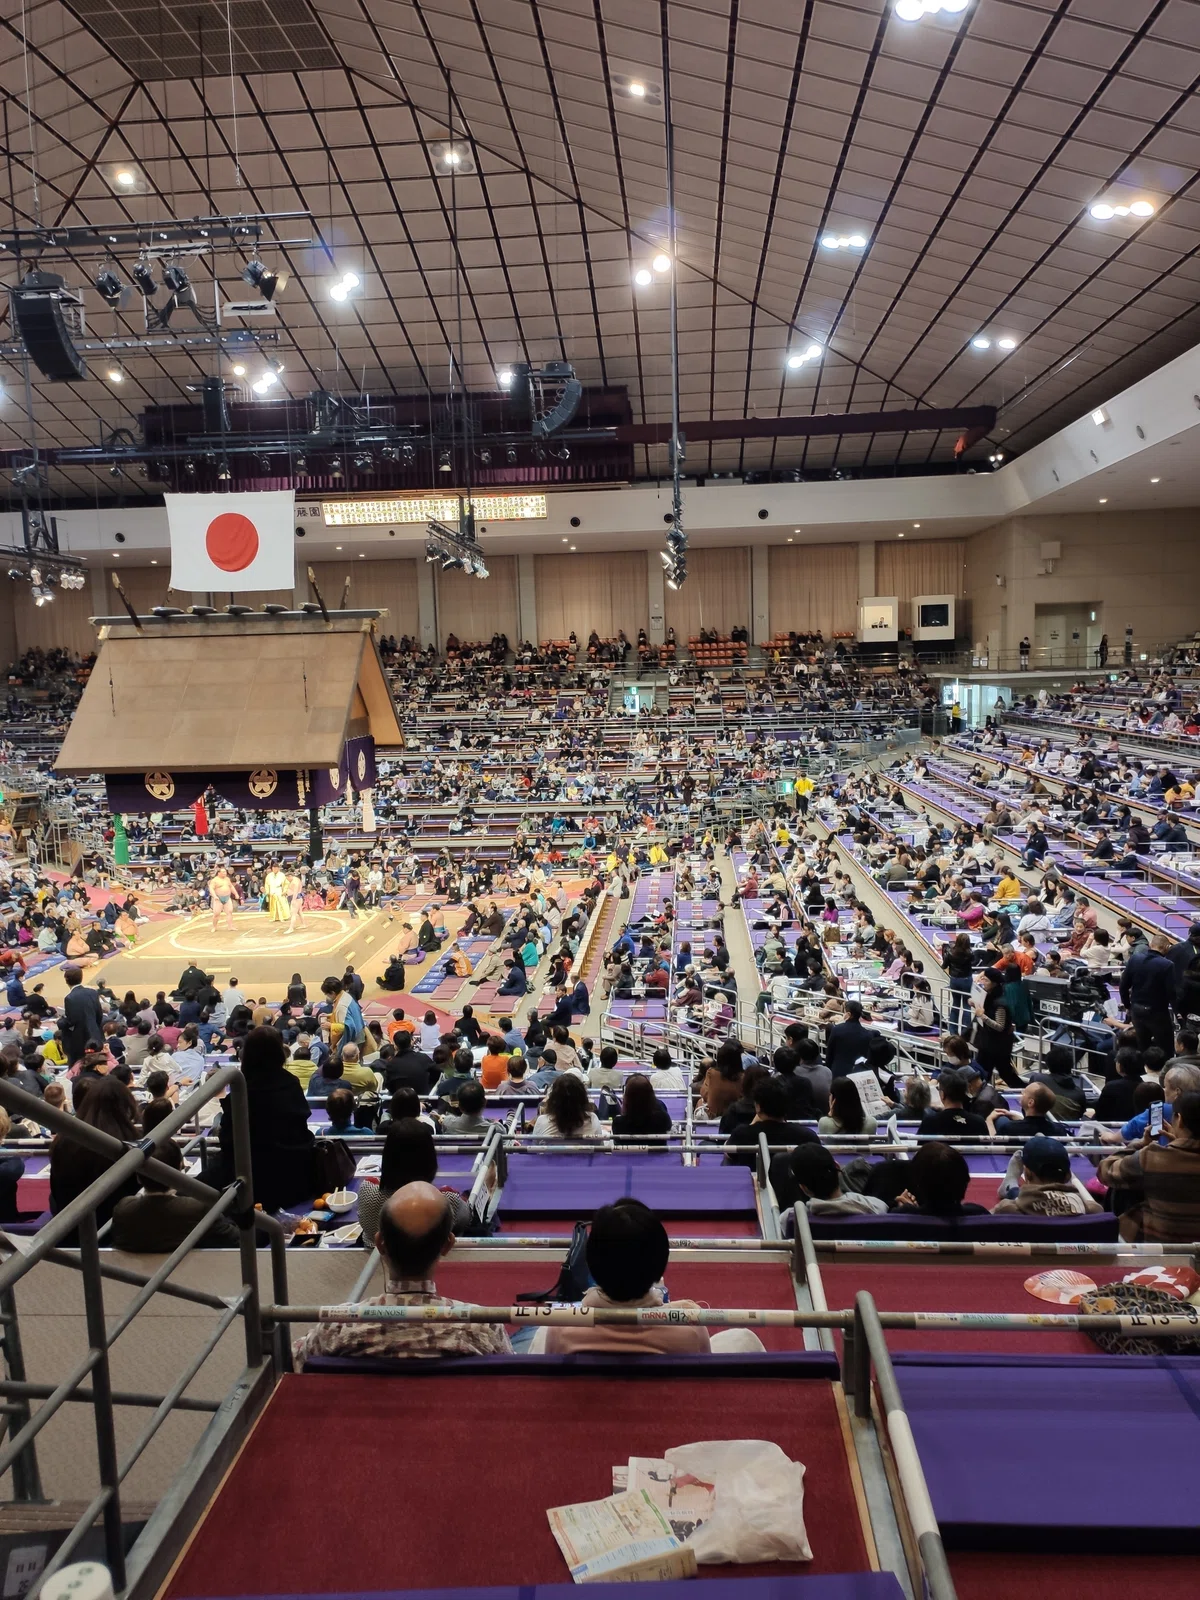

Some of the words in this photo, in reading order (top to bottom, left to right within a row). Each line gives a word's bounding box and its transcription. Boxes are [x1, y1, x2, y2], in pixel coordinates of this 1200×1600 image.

[295, 505, 320, 517] 藤園
[1032, 1195, 1069, 1211] NORTH
[1045, 1205, 1071, 1217] FACE
